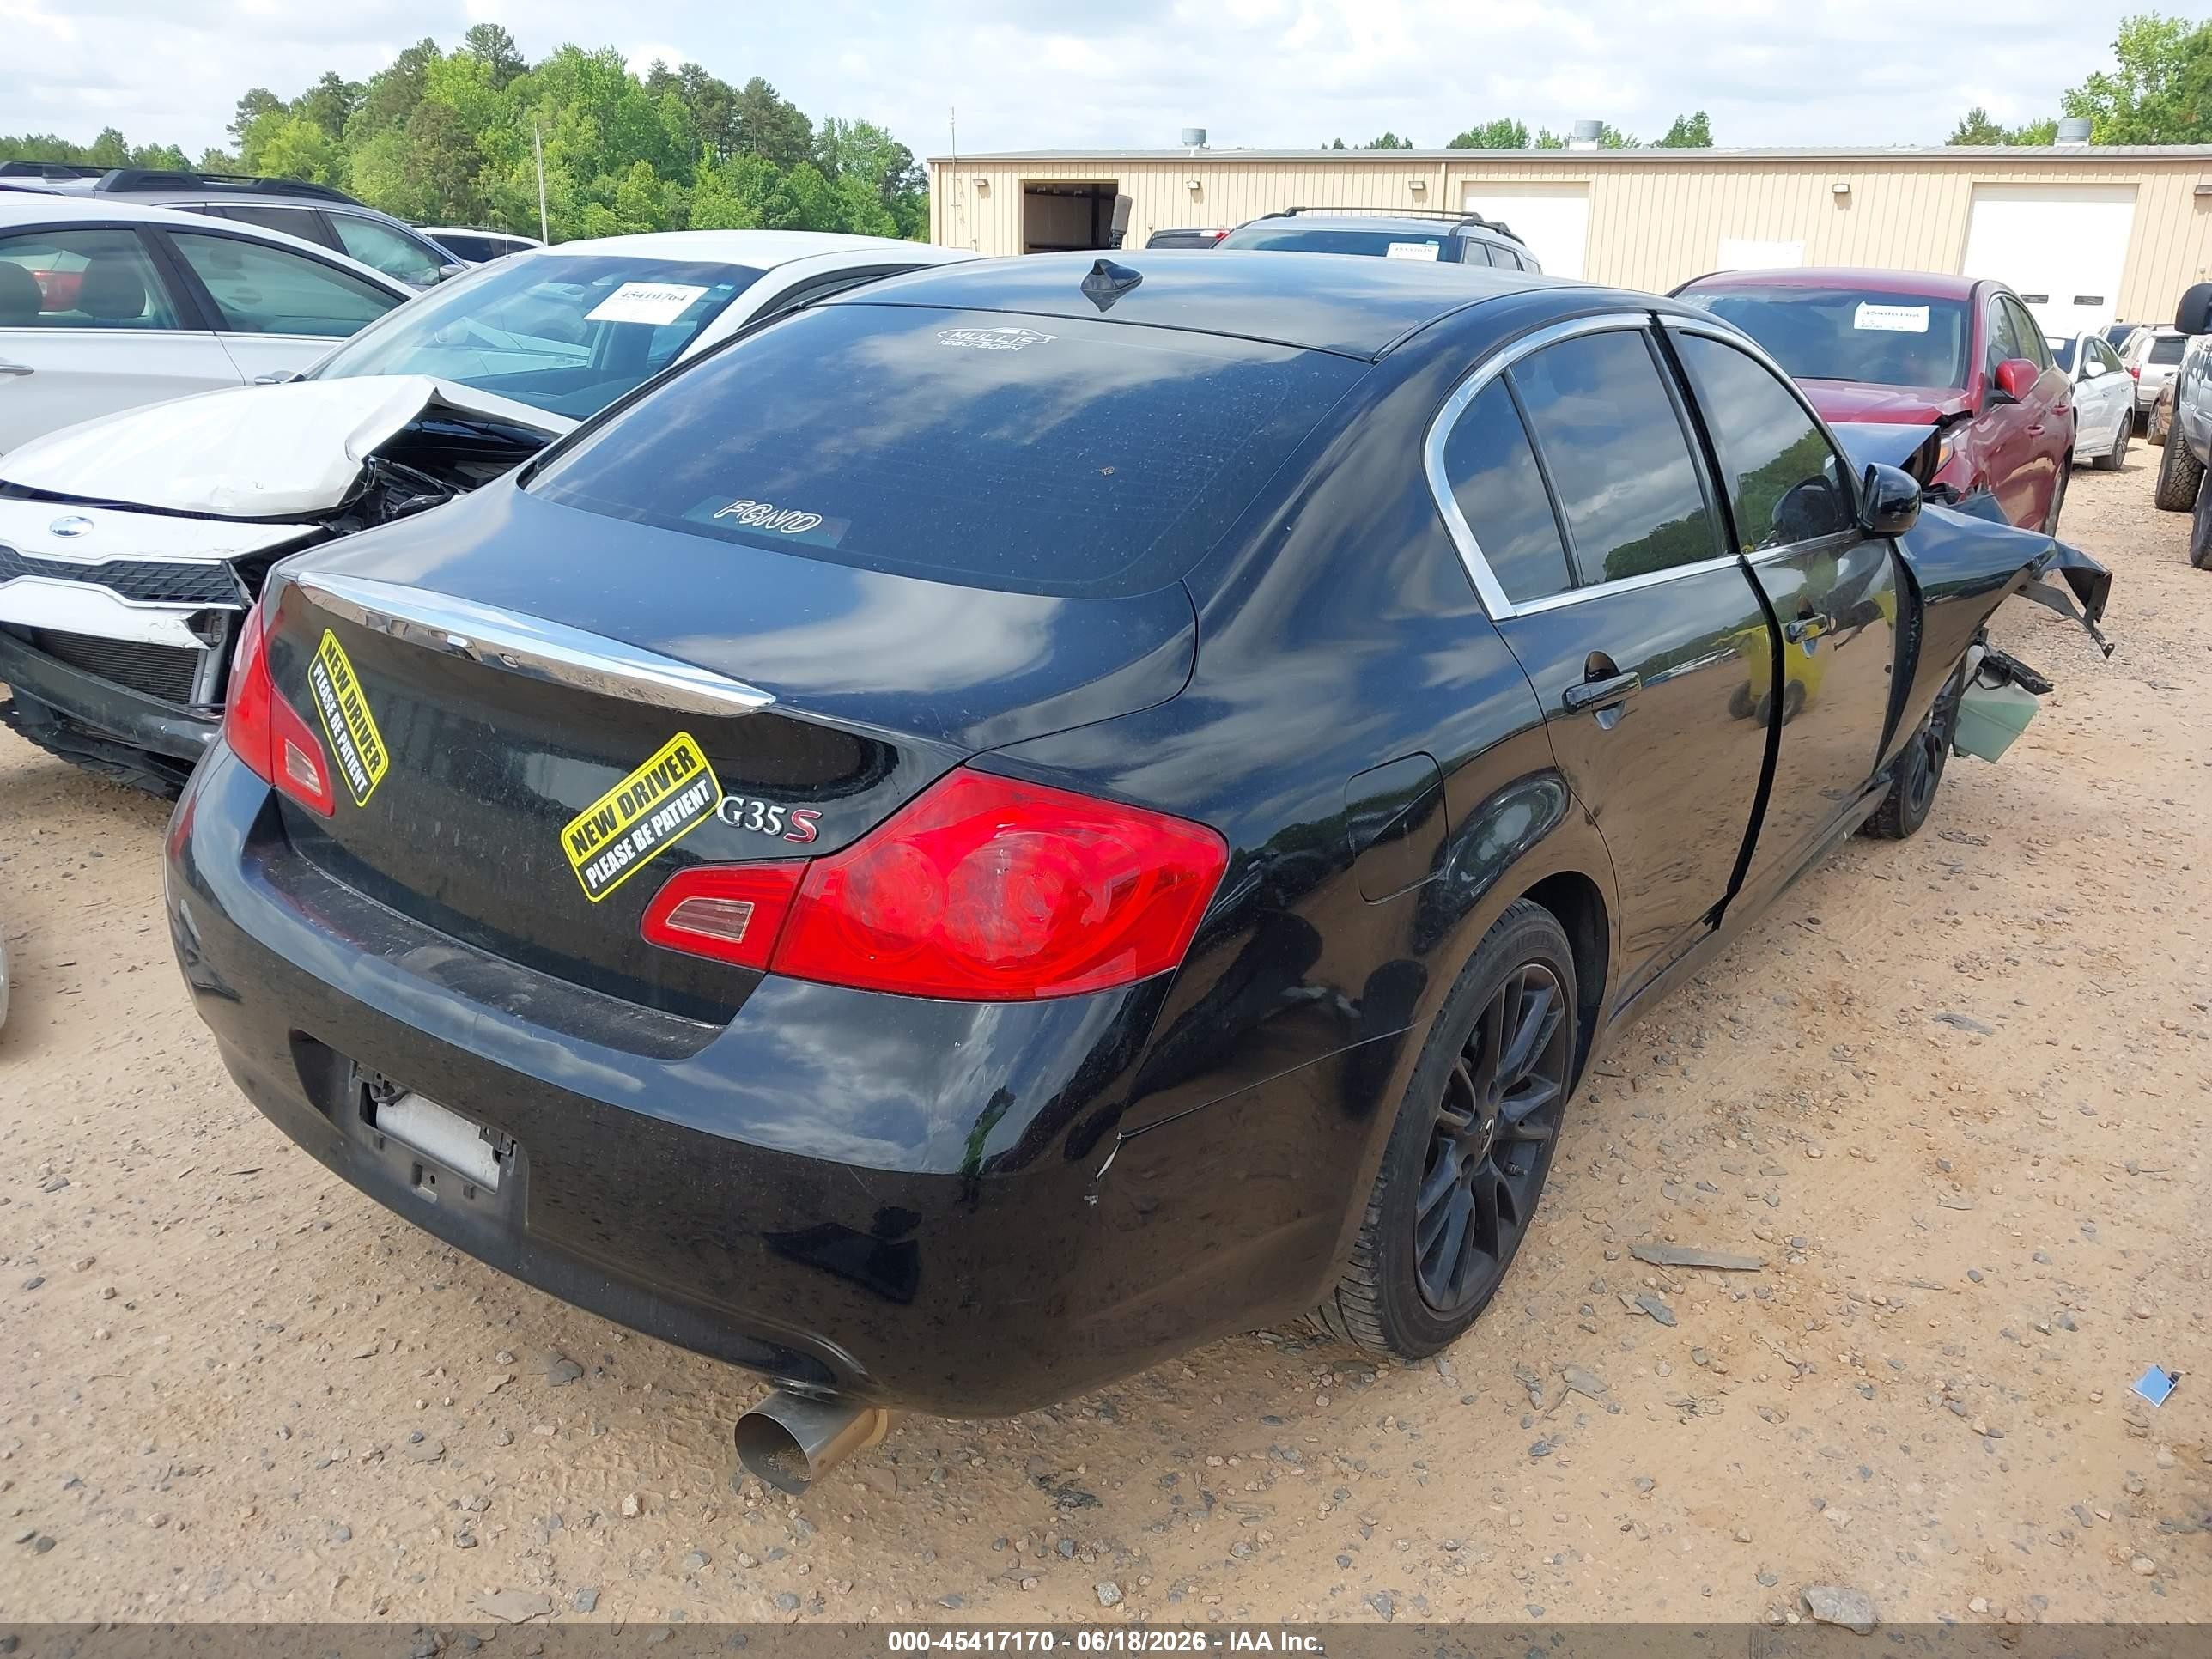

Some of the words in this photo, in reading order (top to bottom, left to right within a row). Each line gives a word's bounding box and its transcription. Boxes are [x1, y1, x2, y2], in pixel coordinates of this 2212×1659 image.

[948, 331, 1037, 344] MULLIS
[313, 662, 337, 718] PLEASE
[330, 711, 343, 738] BE
[337, 730, 368, 793] PATIENT
[325, 641, 351, 692] NEW
[344, 689, 381, 775] DRIVER
[569, 804, 618, 858] NEW
[617, 745, 697, 820] DRIVER
[585, 838, 635, 889] PLEASE
[631, 820, 655, 852] BE
[651, 779, 710, 838] PATIENT
